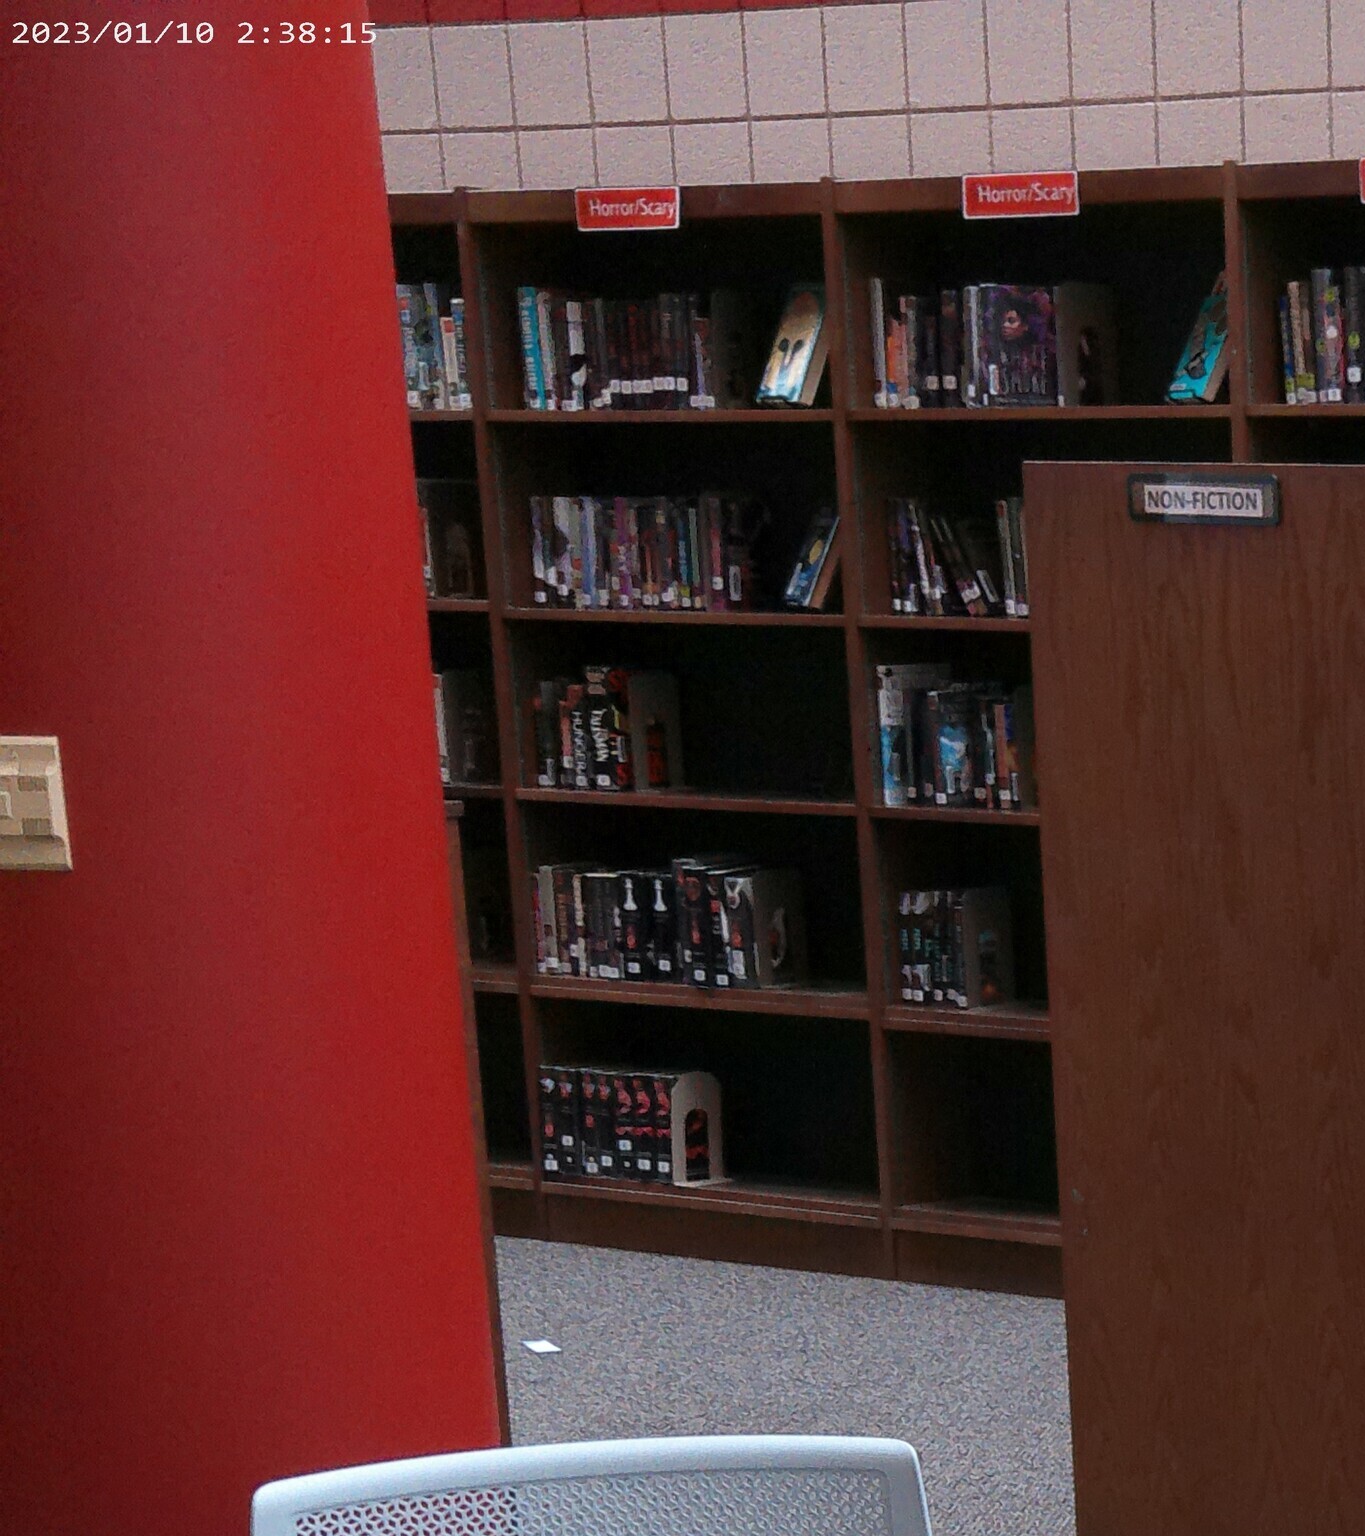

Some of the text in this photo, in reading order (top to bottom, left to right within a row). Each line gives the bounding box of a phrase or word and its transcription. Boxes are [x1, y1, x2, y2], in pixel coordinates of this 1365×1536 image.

[977, 181, 1074, 206] Horror/Scary
[589, 196, 676, 220] Horror/Scary
[1147, 489, 1258, 512] NON-FICTION
[572, 711, 586, 773] HUNGER
